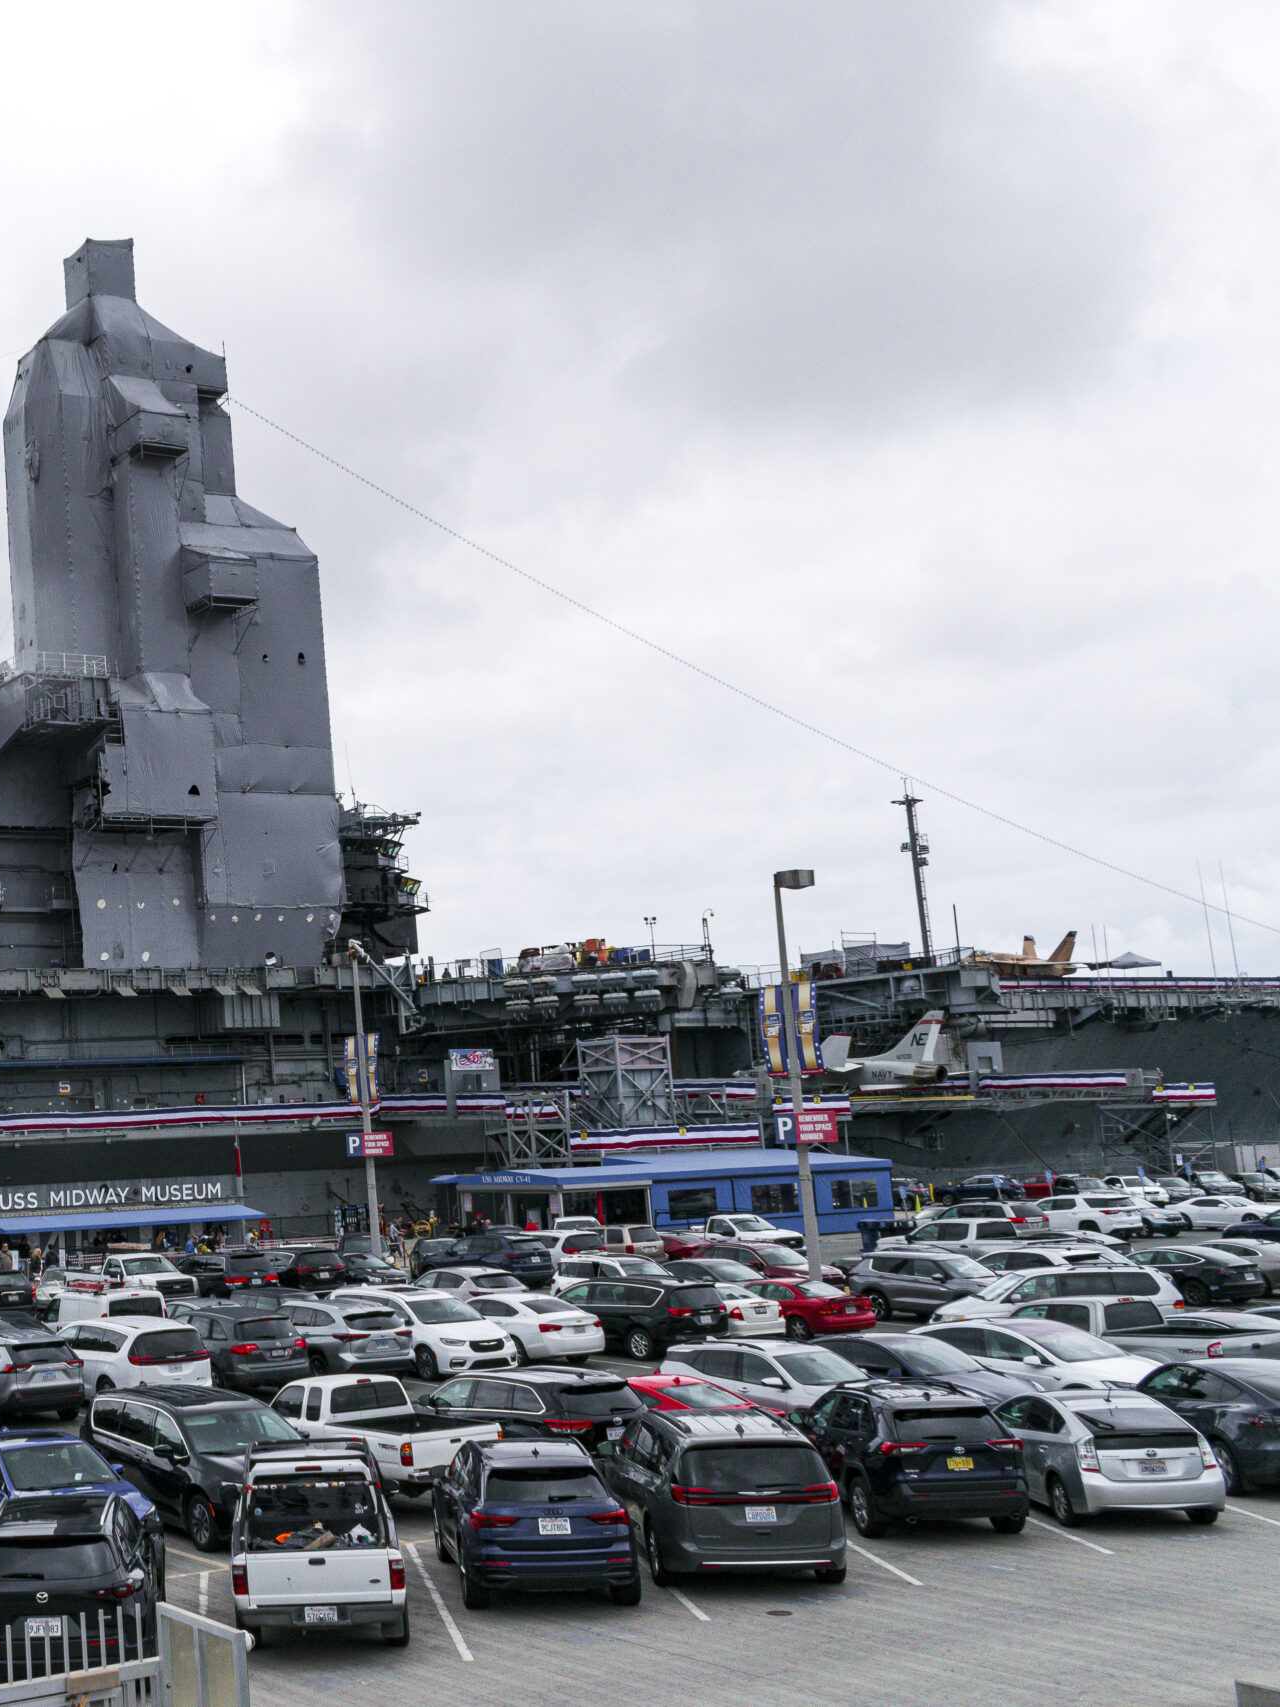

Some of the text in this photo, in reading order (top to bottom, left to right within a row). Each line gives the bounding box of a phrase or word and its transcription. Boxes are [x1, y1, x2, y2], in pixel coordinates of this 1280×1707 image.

[910, 1033, 928, 1046] NE
[871, 1070, 893, 1078] NAVY
[58, 1081, 71, 1093] 5
[798, 1113, 828, 1122] REMEMBER
[777, 1117, 793, 1140] P
[799, 1122, 832, 1131] YOUR SPACE
[800, 1132, 824, 1140] NUMBER
[348, 1136, 360, 1154] P
[365, 1140, 376, 1148] YOUR
[482, 1175, 531, 1183] USS MIDWAY CV-41
[0, 1182, 222, 1210] USS MIDWAY MUSEUM
